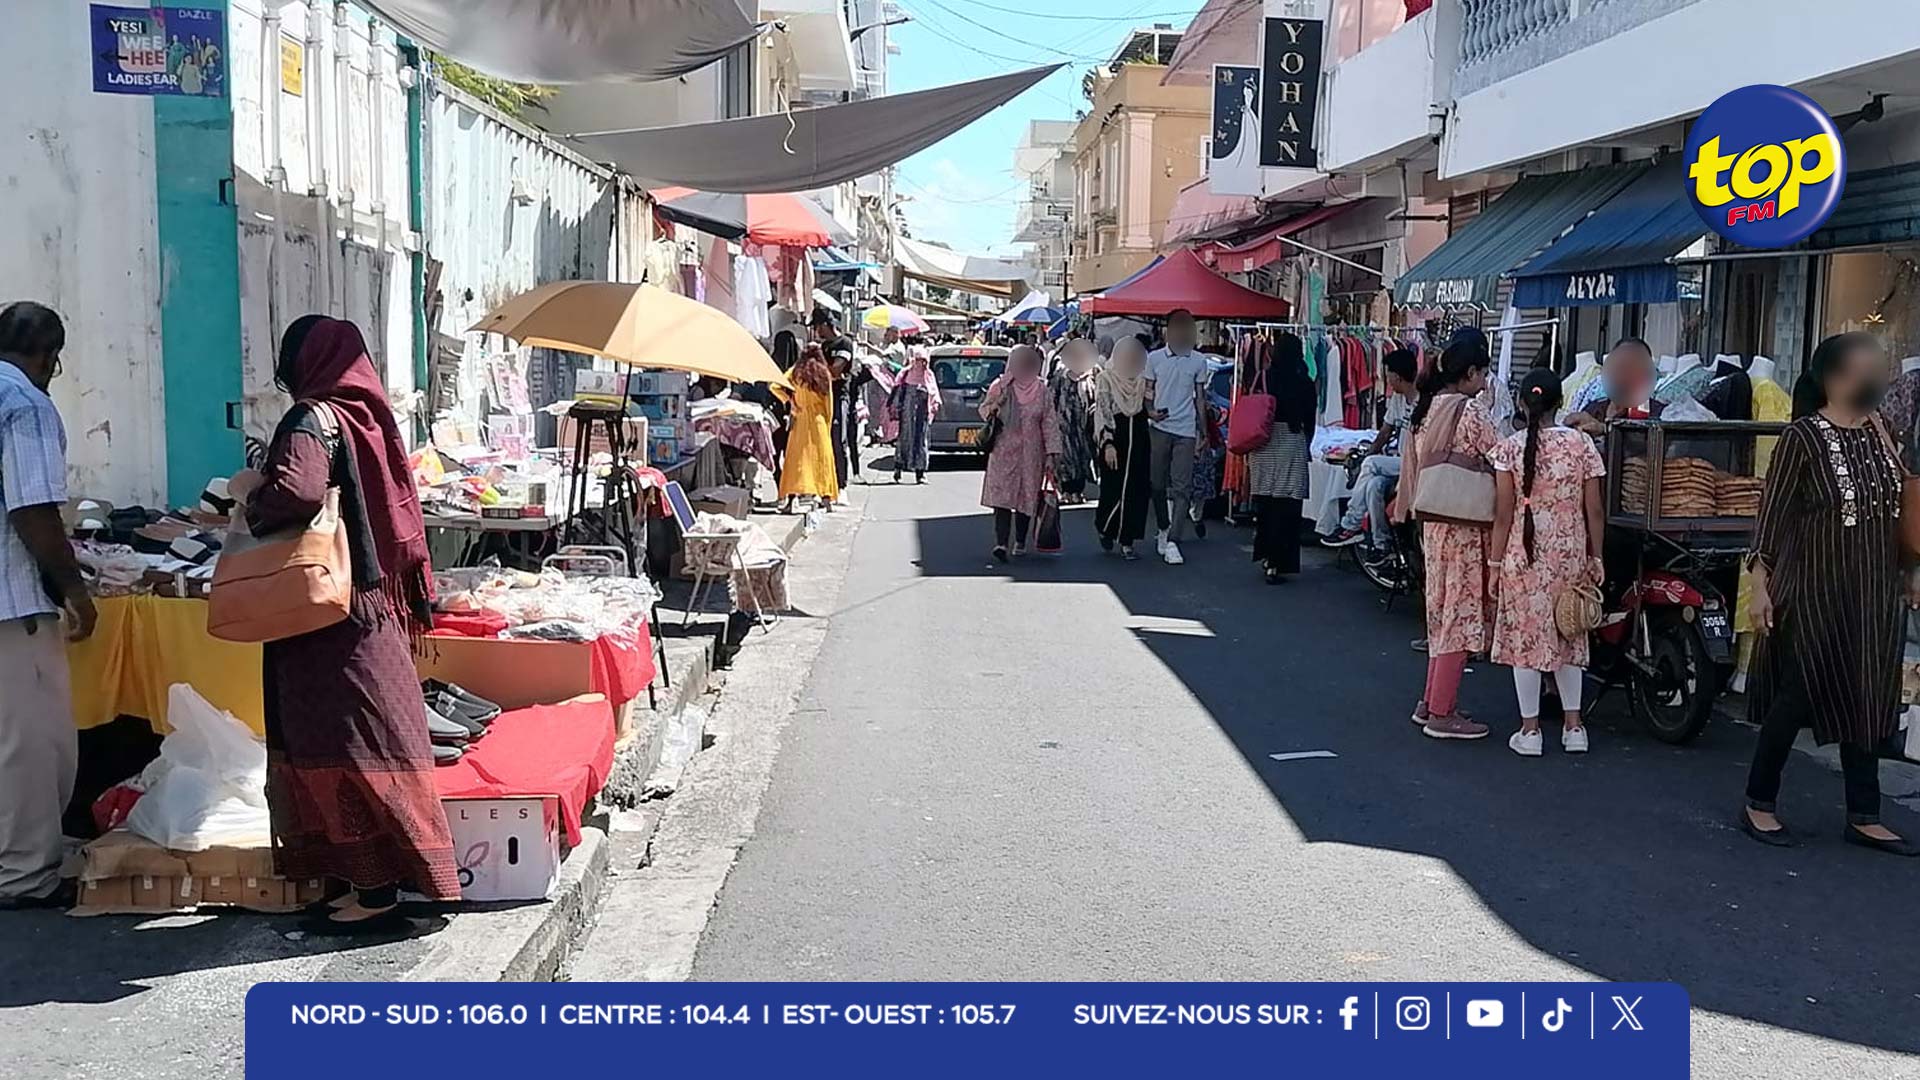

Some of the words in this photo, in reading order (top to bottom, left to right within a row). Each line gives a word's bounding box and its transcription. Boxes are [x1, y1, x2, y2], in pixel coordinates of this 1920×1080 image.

[122, 35, 162, 50] WEE
[131, 50, 164, 66] HEE
[1277, 22, 1305, 162] YOHAN
[1436, 279, 1474, 304] FASHION
[1566, 272, 1616, 300] ALYAZ
[1713, 626, 1722, 637] R
